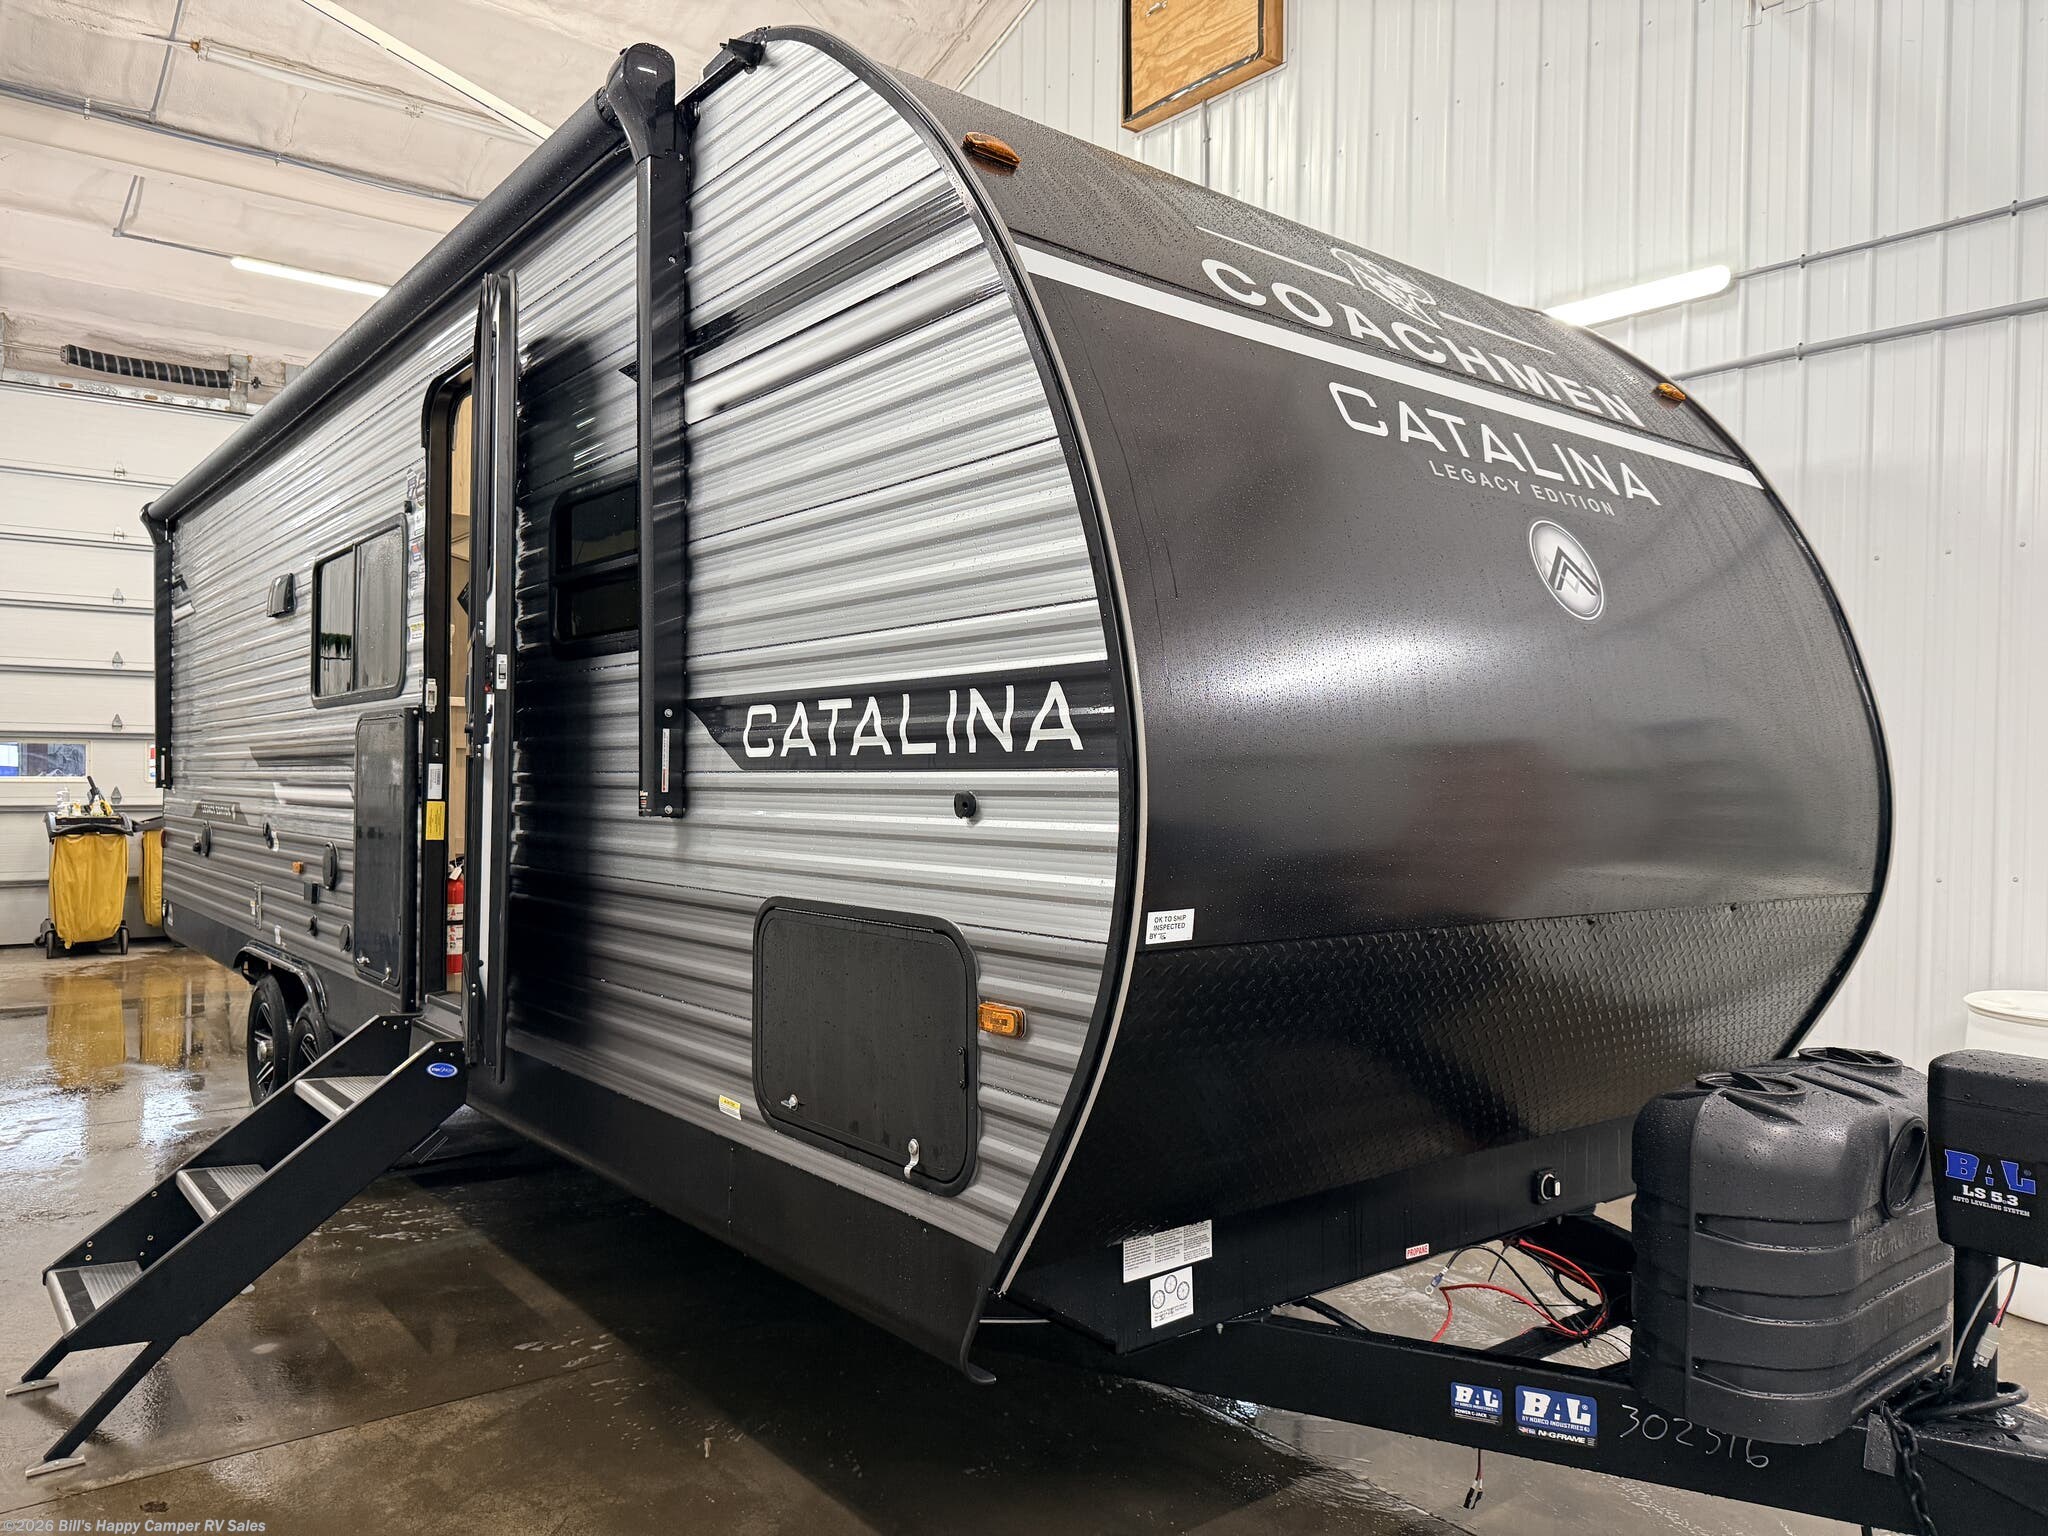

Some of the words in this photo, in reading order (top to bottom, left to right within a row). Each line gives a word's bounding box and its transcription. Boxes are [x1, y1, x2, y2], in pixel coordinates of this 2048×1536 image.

[1201, 258, 1646, 427] COACHMEN
[1328, 382, 1661, 506] CATALINA
[1429, 460, 1522, 494] LEGACY
[1530, 484, 1616, 517] EDITION
[742, 681, 1084, 758] CATALINA
[1153, 922, 1186, 931] INSPECTED
[1154, 916, 1163, 924] OK
[1173, 914, 1187, 922] SHIP
[1945, 1149, 2036, 1195] BAL
[1952, 1195, 1970, 1204] AUTO
[1971, 1199, 2002, 1212] LEVELING
[2003, 1206, 2031, 1218] SYSTEM
[1962, 1184, 1987, 1200] LS
[1455, 1385, 1499, 1408] BAL
[1522, 1390, 1591, 1426] BAL
[1529, 1417, 1549, 1426] NORCO
[1550, 1419, 1584, 1432] INDUSTRIES
